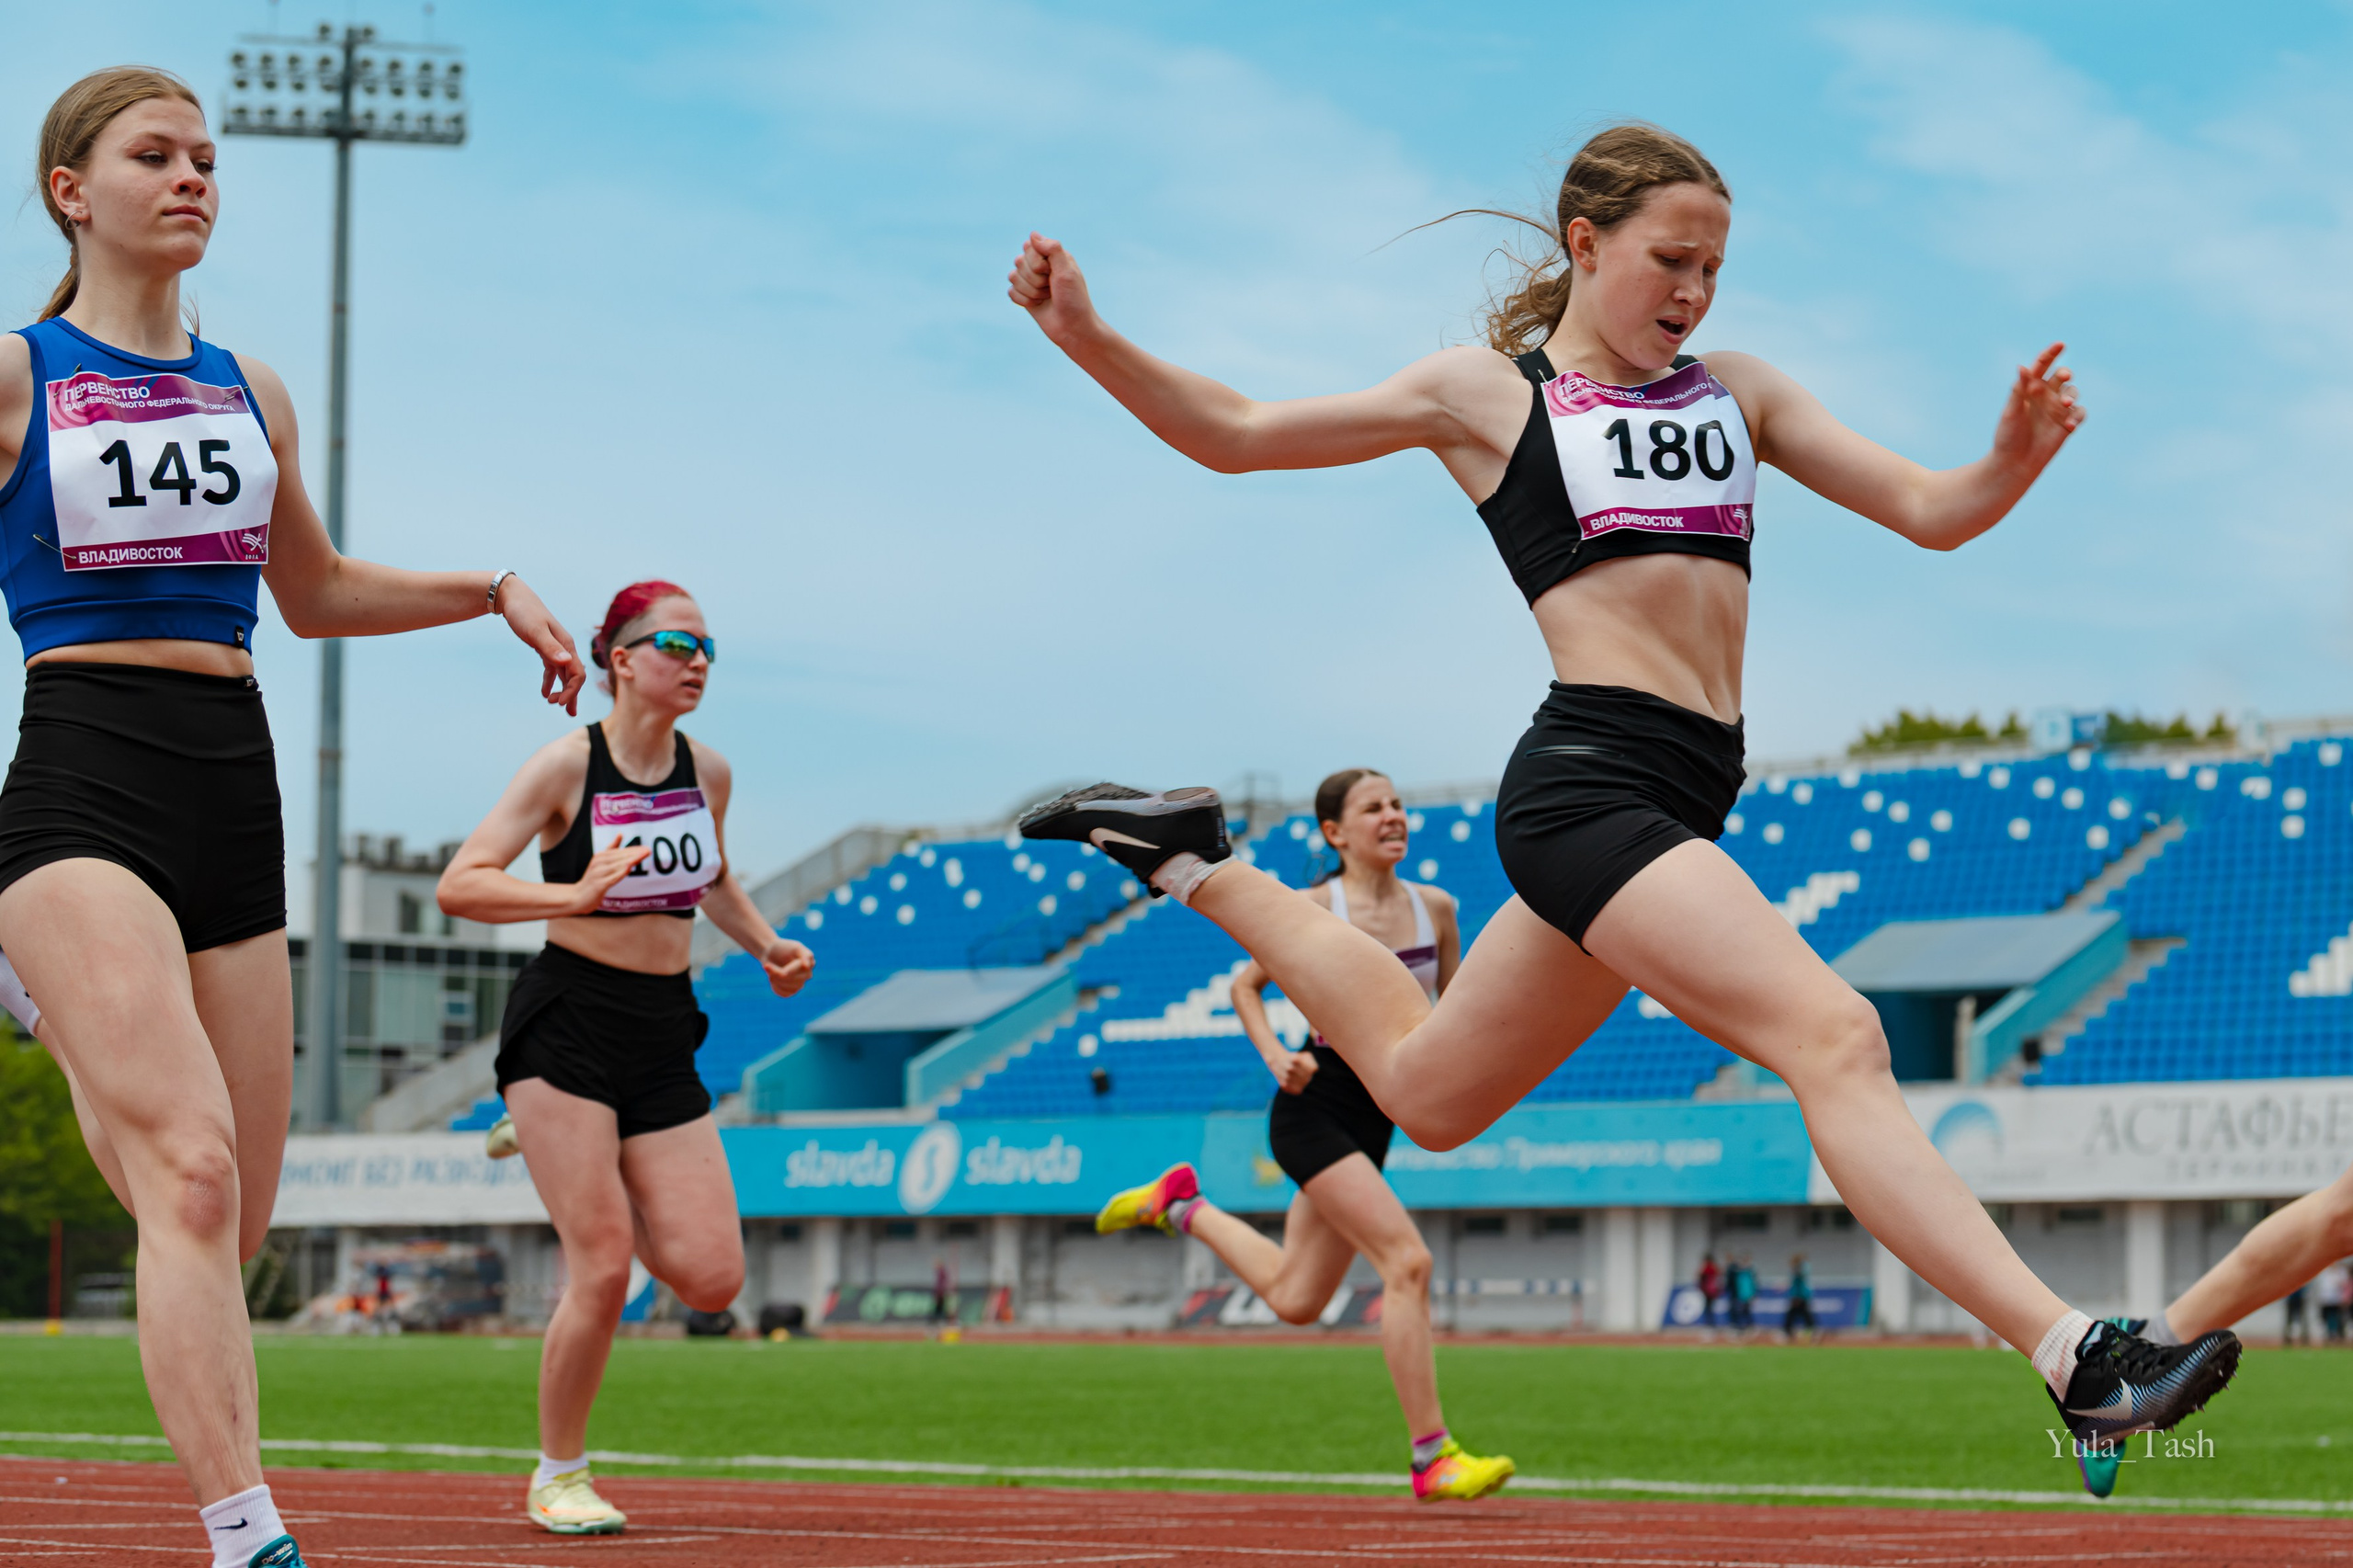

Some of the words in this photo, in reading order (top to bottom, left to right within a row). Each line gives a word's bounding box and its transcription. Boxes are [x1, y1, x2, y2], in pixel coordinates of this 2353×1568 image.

[63, 381, 151, 403] ПЕРВЕНСТВО
[1559, 377, 1644, 399] ПЕРВЕНСТВО
[1643, 382, 1708, 405] ФЕДЕРАЛЬНОГО
[64, 395, 145, 412] ДАЛЬНЕВОСТОЧНОГО
[147, 397, 208, 409] ФЕДЕРАЛЬНОГО
[209, 403, 235, 412] ОКРУГА
[1601, 418, 1734, 482] 180
[98, 439, 241, 507] 145
[1590, 511, 1685, 530] ВЛАДИВОСТОК
[78, 546, 184, 564] ВЛАДИВОСТОК
[783, 1138, 896, 1188] slavda
[964, 1133, 1082, 1185] slavda
